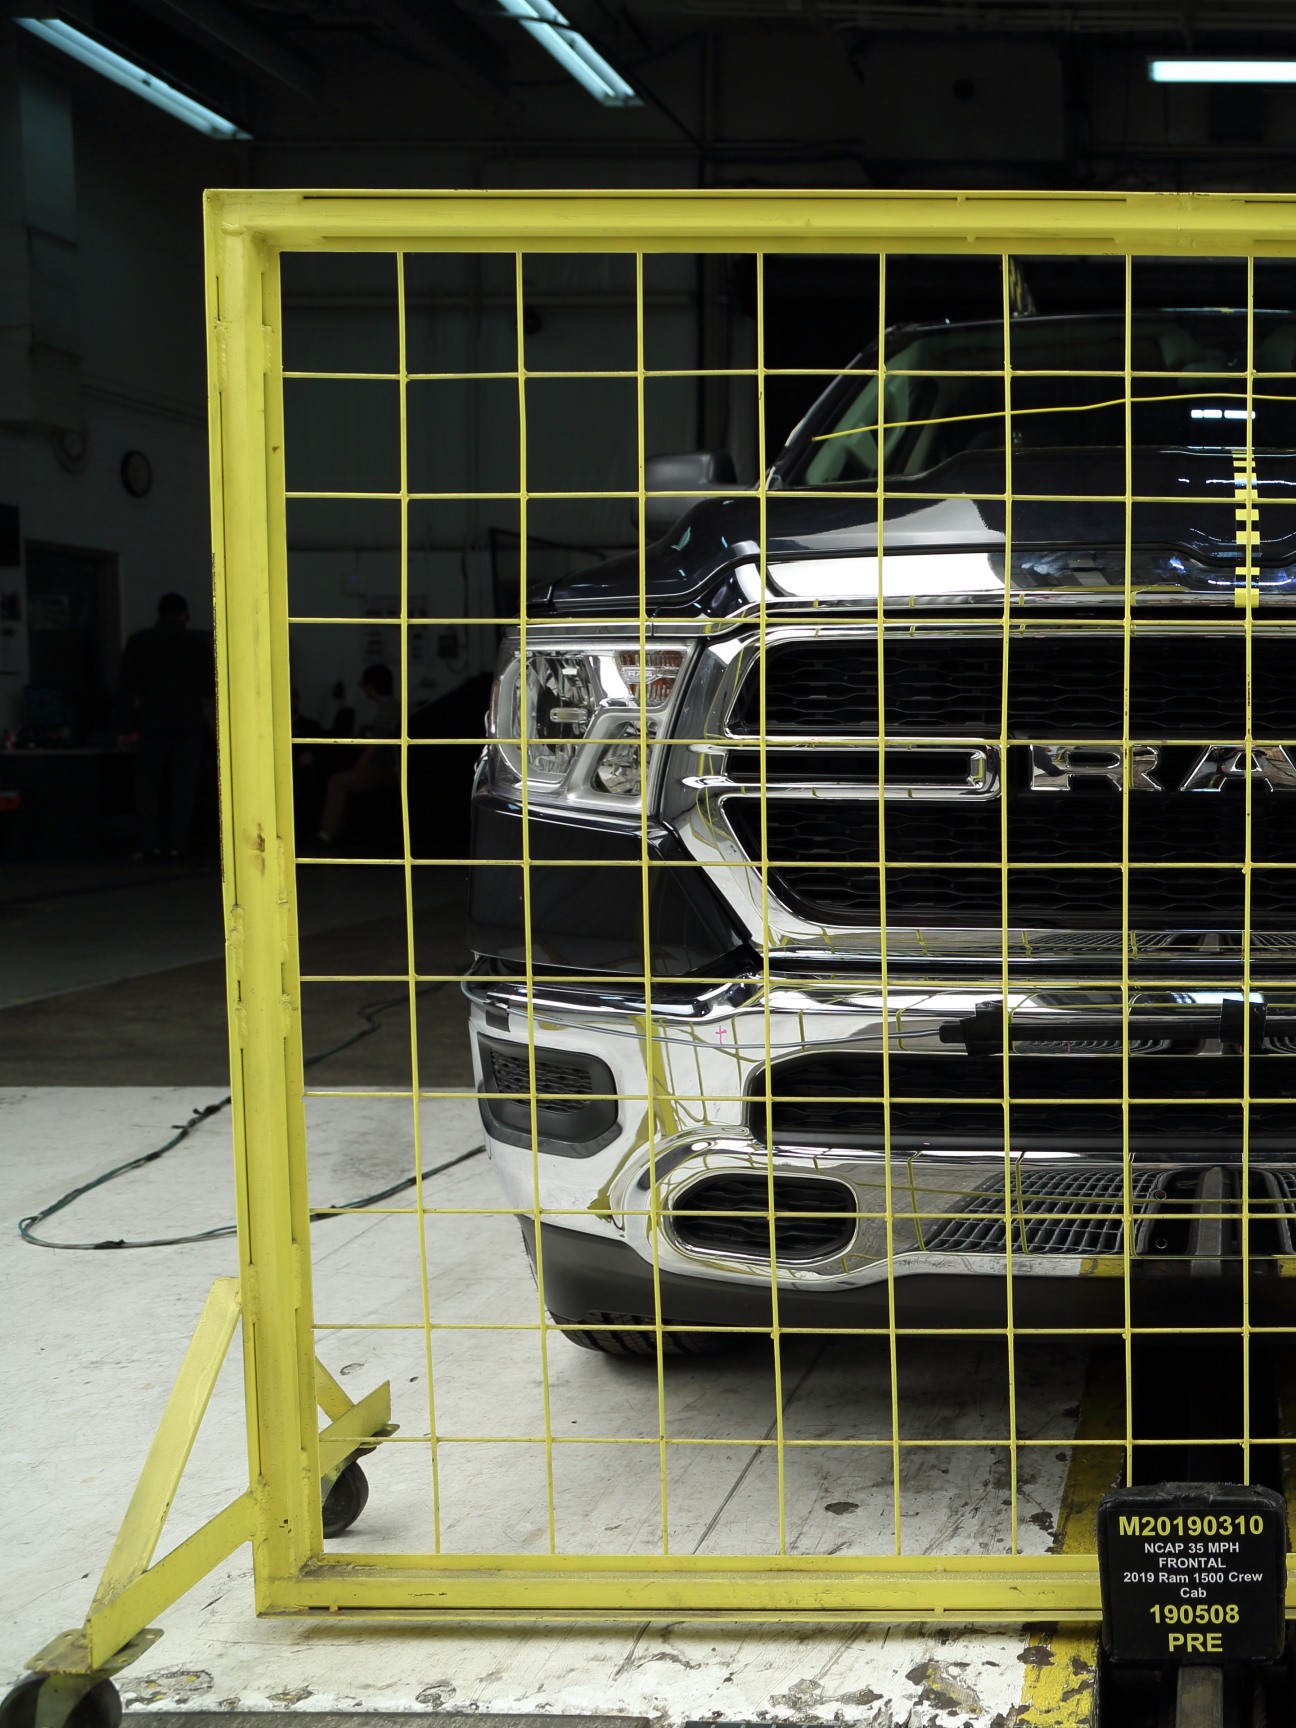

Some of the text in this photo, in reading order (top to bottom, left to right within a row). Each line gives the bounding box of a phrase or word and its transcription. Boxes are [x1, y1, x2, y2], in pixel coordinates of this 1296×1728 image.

[1119, 1515, 1264, 1536] M20190310
[1144, 1542, 1239, 1553] NCAP 35 MPH
[1159, 1558, 1226, 1568] FRONTAL
[1123, 1571, 1263, 1583] 2019 Ram 1500 Crew
[1180, 1587, 1207, 1598] Cab
[1150, 1604, 1239, 1624] 190508
[1168, 1633, 1223, 1652] PRE
